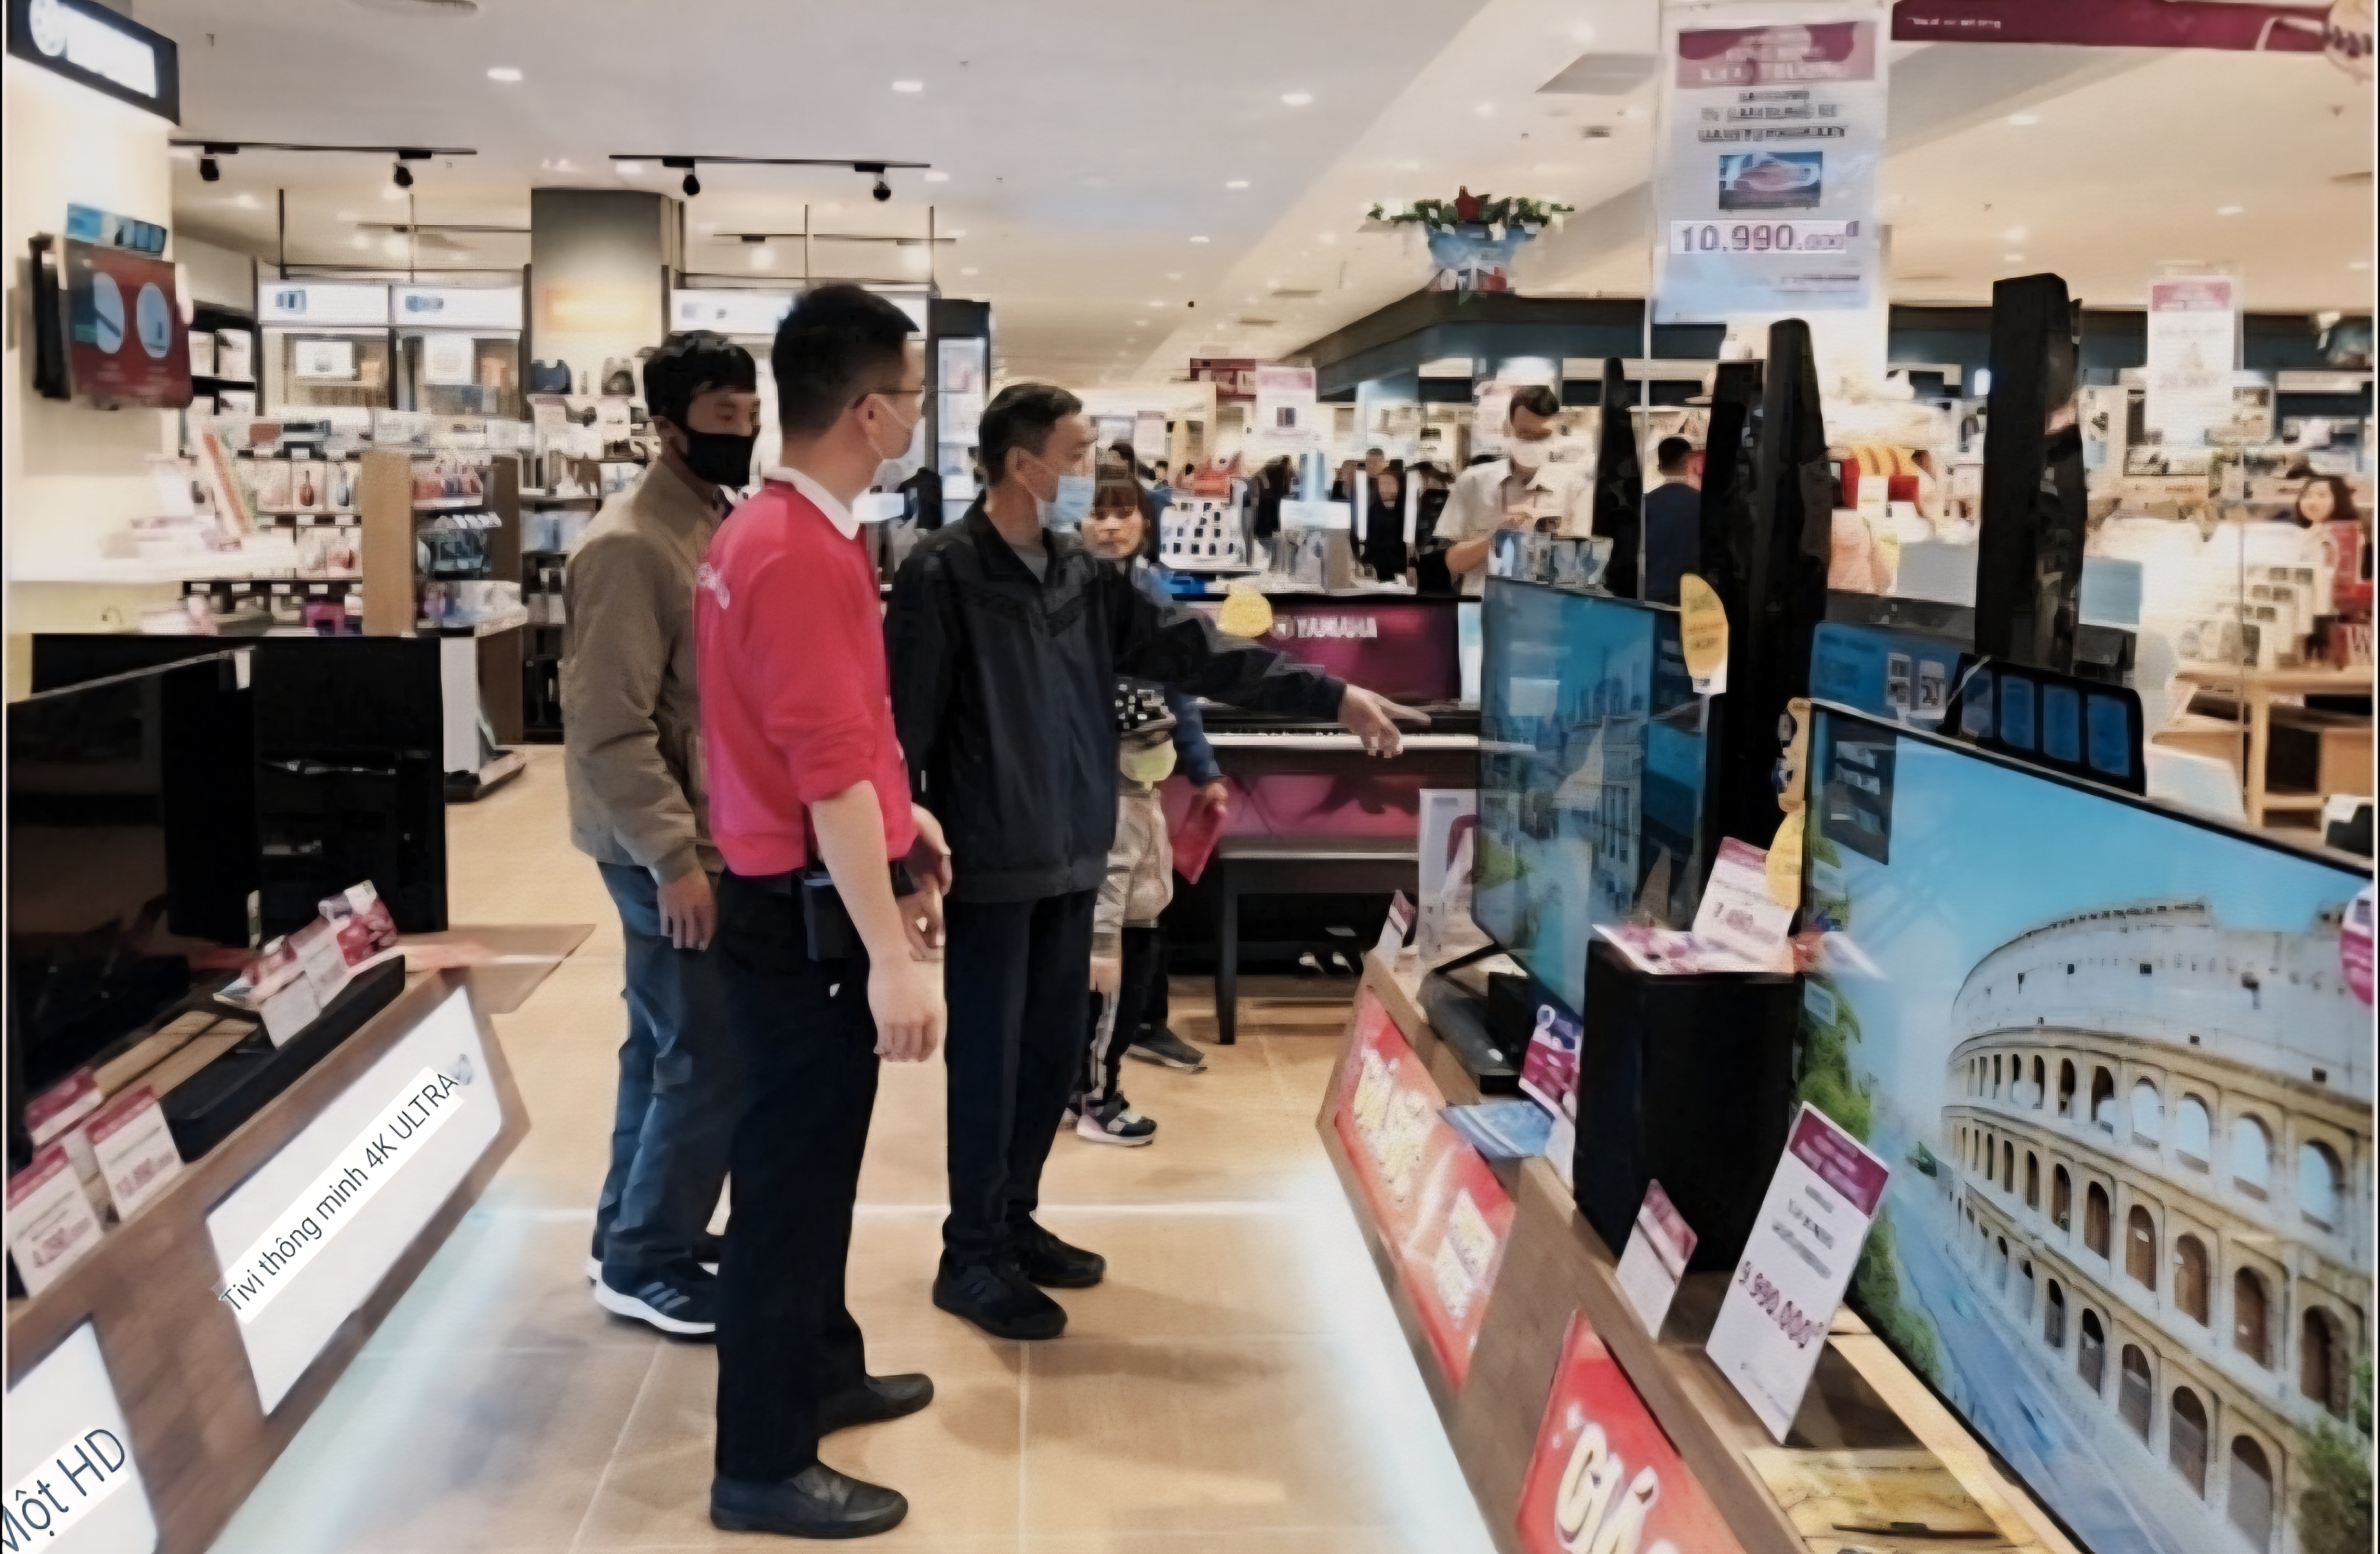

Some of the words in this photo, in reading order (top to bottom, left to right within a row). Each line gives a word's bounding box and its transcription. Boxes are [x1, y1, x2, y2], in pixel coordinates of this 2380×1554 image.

[221, 1269, 264, 1310] Tivi
[258, 1216, 322, 1276] thông
[316, 1168, 369, 1220] minh
[366, 1133, 398, 1168] 4K
[388, 1073, 459, 1140] ULTRA
[56, 1428, 126, 1497] HD
